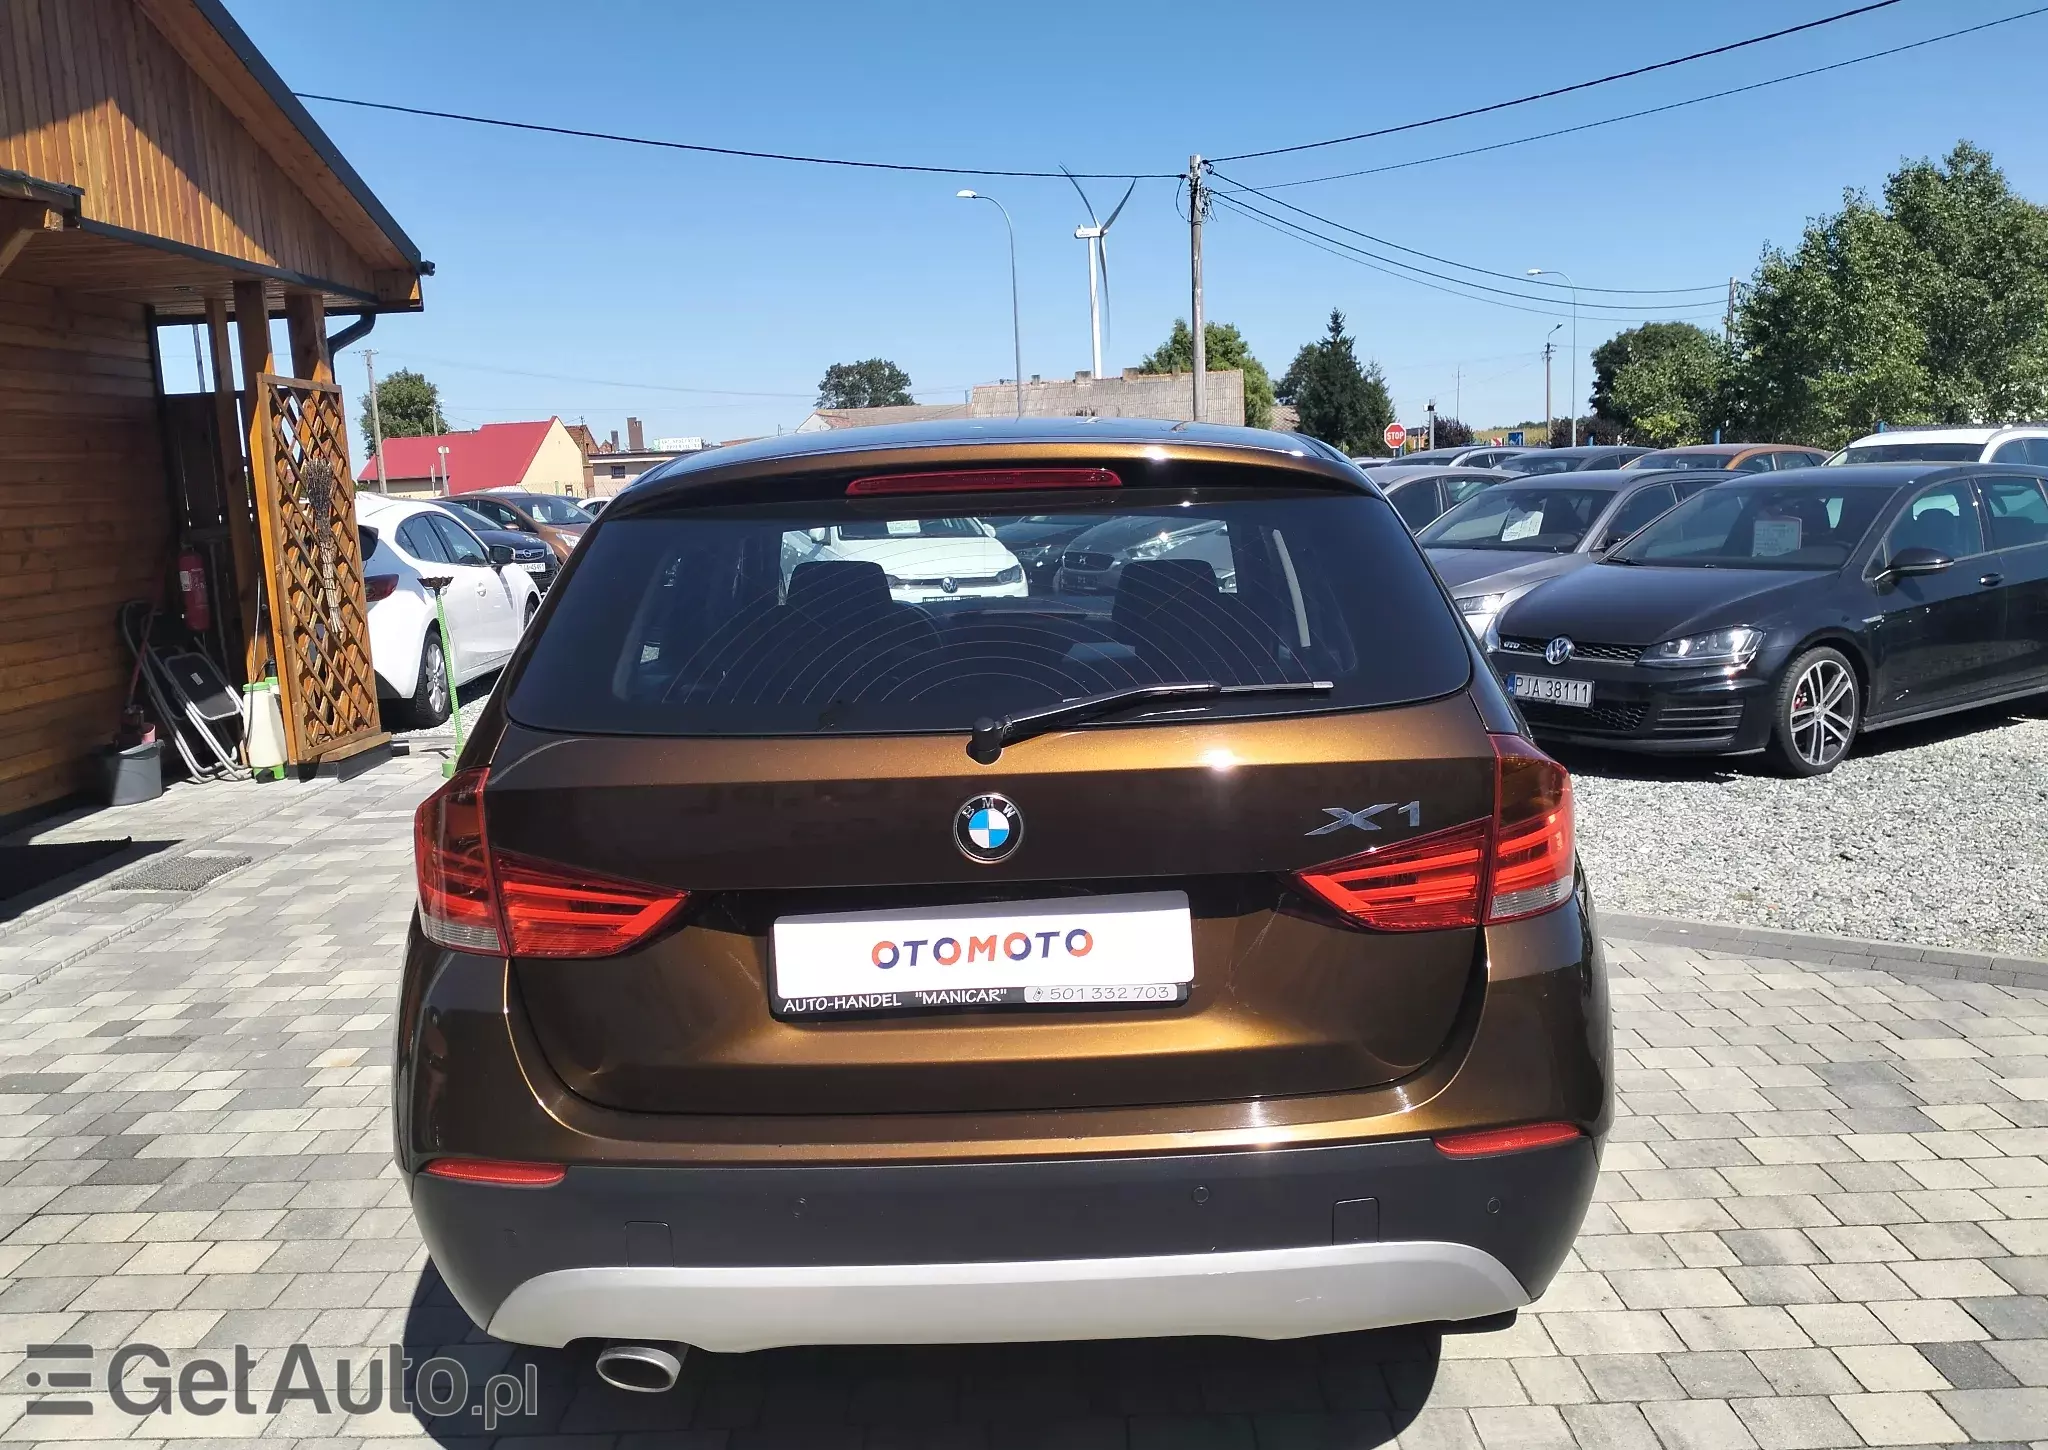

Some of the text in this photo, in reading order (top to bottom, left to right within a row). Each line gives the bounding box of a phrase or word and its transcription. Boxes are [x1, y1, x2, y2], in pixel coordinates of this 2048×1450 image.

[1386, 431, 1404, 440] STOP
[1503, 641, 1520, 649] GTD
[1515, 677, 1540, 696] PJA
[1546, 680, 1588, 702] 38111
[961, 797, 1016, 819] BMW
[1304, 800, 1420, 836] X1
[871, 928, 1094, 970] OTOMOTO
[783, 986, 1169, 1013] AUTO-HANDEL "MANICAR" 501 332 703
